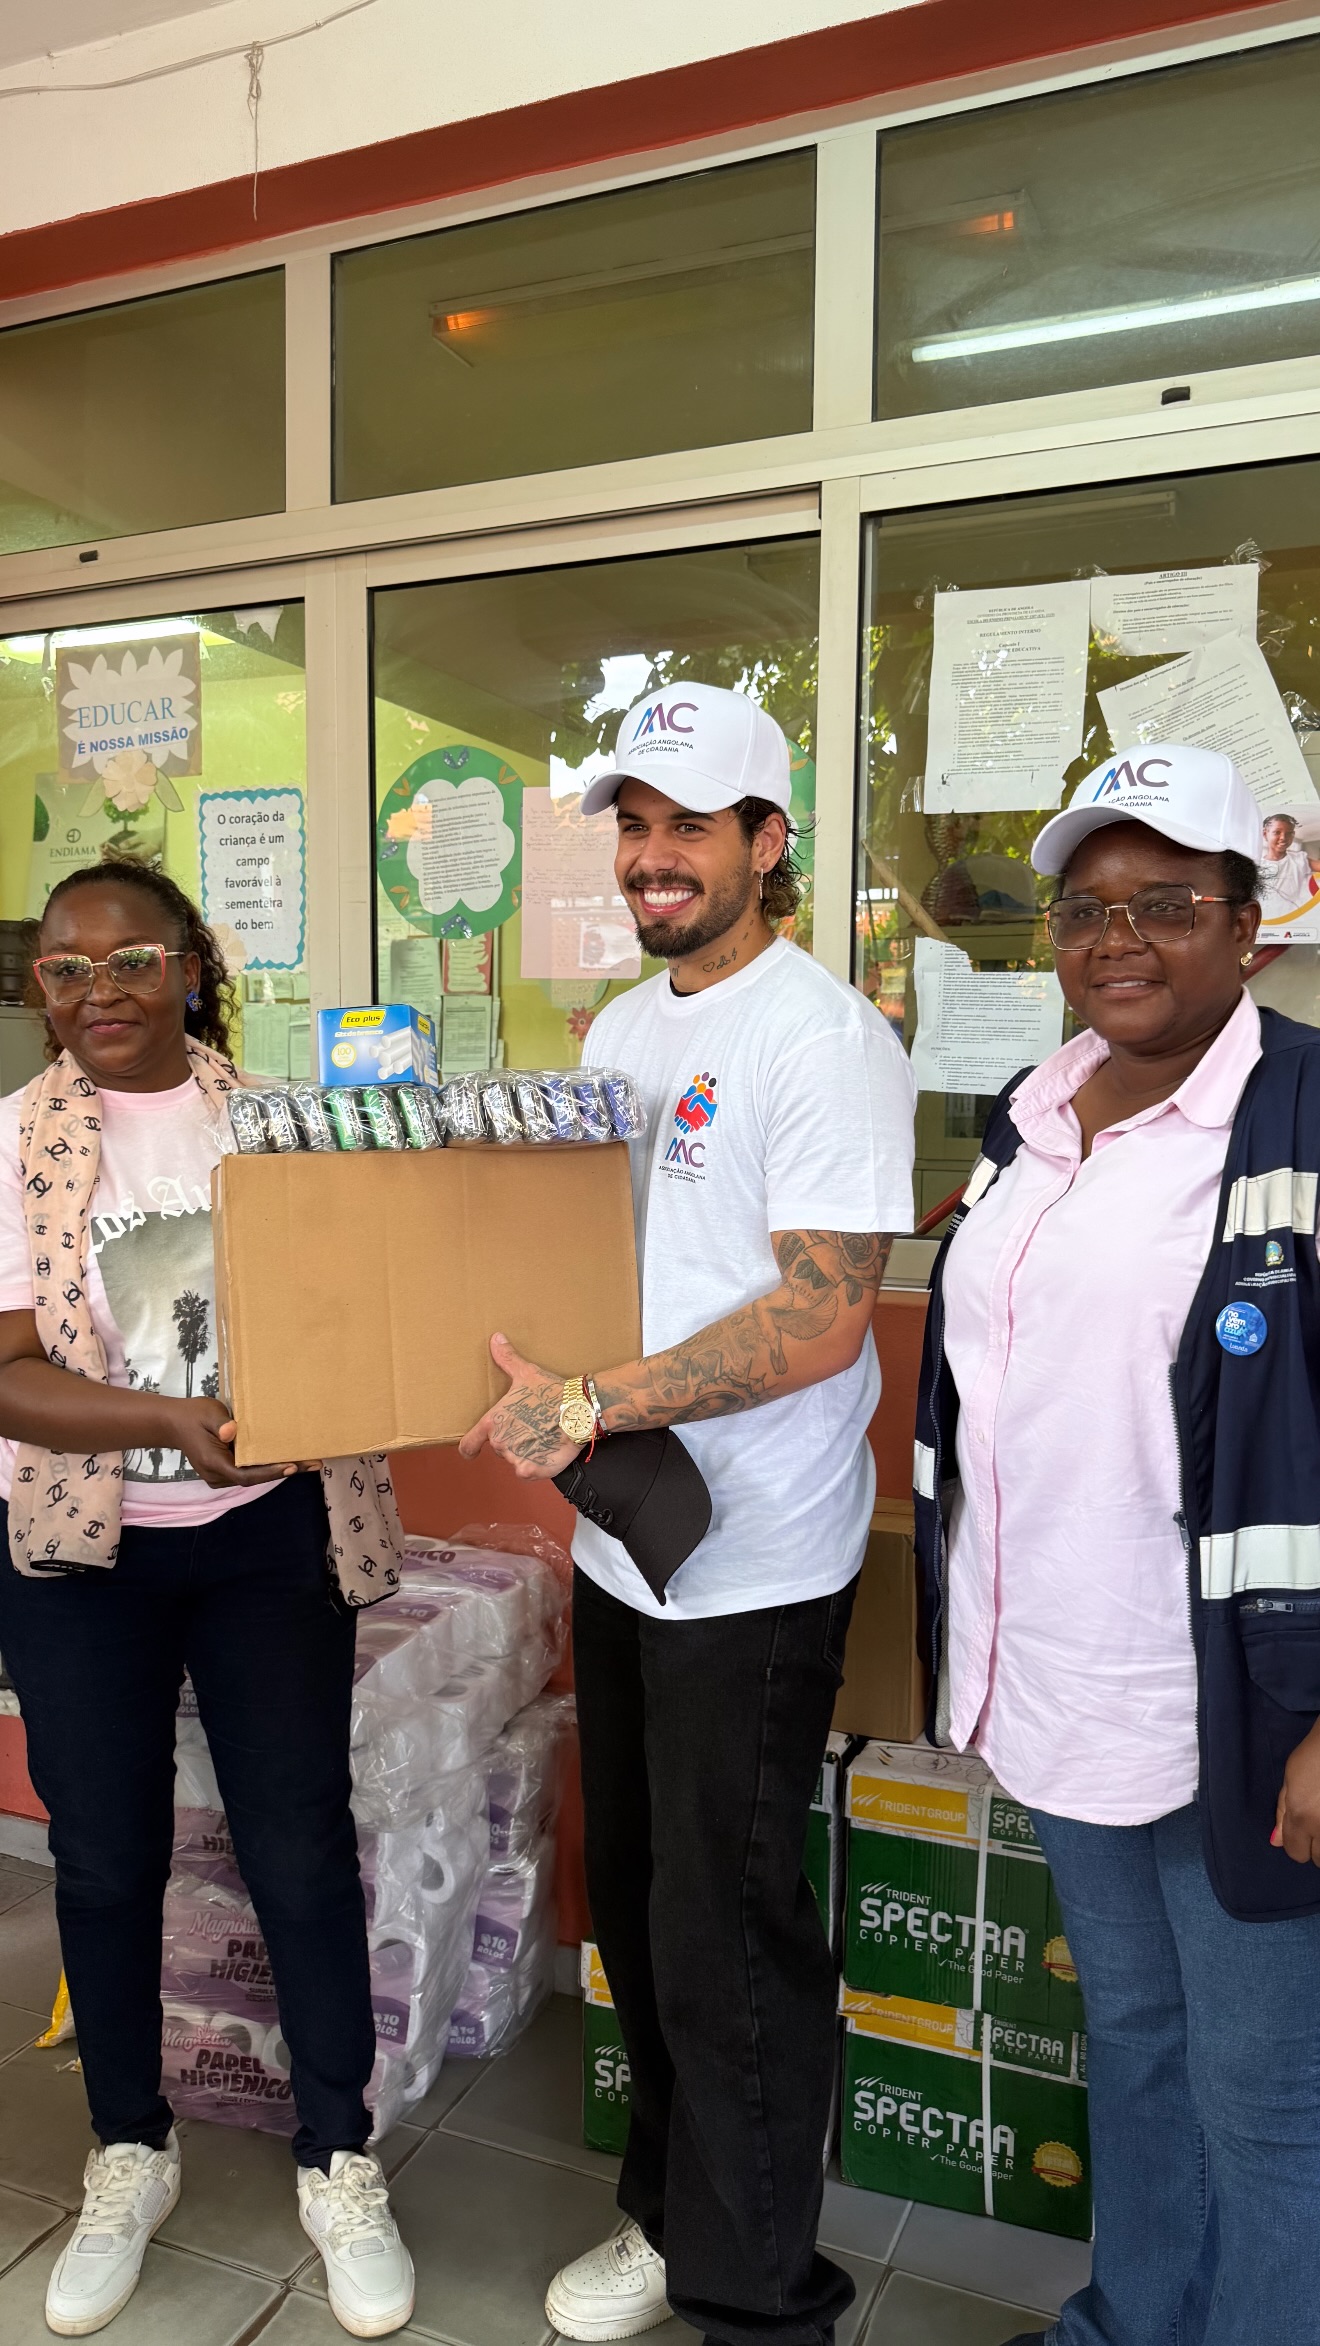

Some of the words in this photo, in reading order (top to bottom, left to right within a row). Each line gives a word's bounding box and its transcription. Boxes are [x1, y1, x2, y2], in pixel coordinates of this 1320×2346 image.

[77, 697, 176, 728] EDUCAR
[77, 740, 86, 754] É
[89, 736, 135, 753] NOSSA
[138, 727, 188, 746] MISSÃO
[658, 739, 694, 749] ANGOLANA
[1127, 794, 1170, 803] ANGOLANA
[217, 814, 226, 825] O
[229, 811, 270, 826] coração
[272, 810, 285, 822] da
[219, 834, 257, 848] criança
[259, 832, 266, 844] é
[268, 834, 285, 844] um
[49, 846, 97, 858] ENDIAMA
[235, 857, 270, 868] campo
[224, 875, 273, 889] favorável
[275, 875, 282, 887] à
[225, 898, 283, 910] sementeira
[235, 919, 248, 931] do
[251, 918, 274, 930] bem
[362, 1015, 381, 1023] plus
[992, 1827, 1035, 1840] COPIER
[885, 1888, 932, 1906] TRIDENT
[860, 1897, 1026, 1960] SPECTRA
[491, 1936, 508, 1951] 10
[860, 1929, 938, 1955] COPIER
[947, 1960, 966, 1972] The
[994, 1970, 1024, 1985] Paper
[375, 2023, 399, 2037] OLOS
[980, 2024, 1064, 2059] PECTRA
[195, 2048, 266, 2075] PAPEL
[1027, 2051, 1064, 2065] PAPER
[180, 2068, 292, 2101] HIGIÊNICO
[878, 2082, 924, 2101] TRIDENT
[853, 2090, 1015, 2157] SPECTRA
[853, 2120, 930, 2149] COPIER
[946, 2143, 1014, 2170] PAPER
[940, 2154, 957, 2167] The
[958, 2158, 983, 2174] Good
[990, 2169, 1014, 2181] aper
